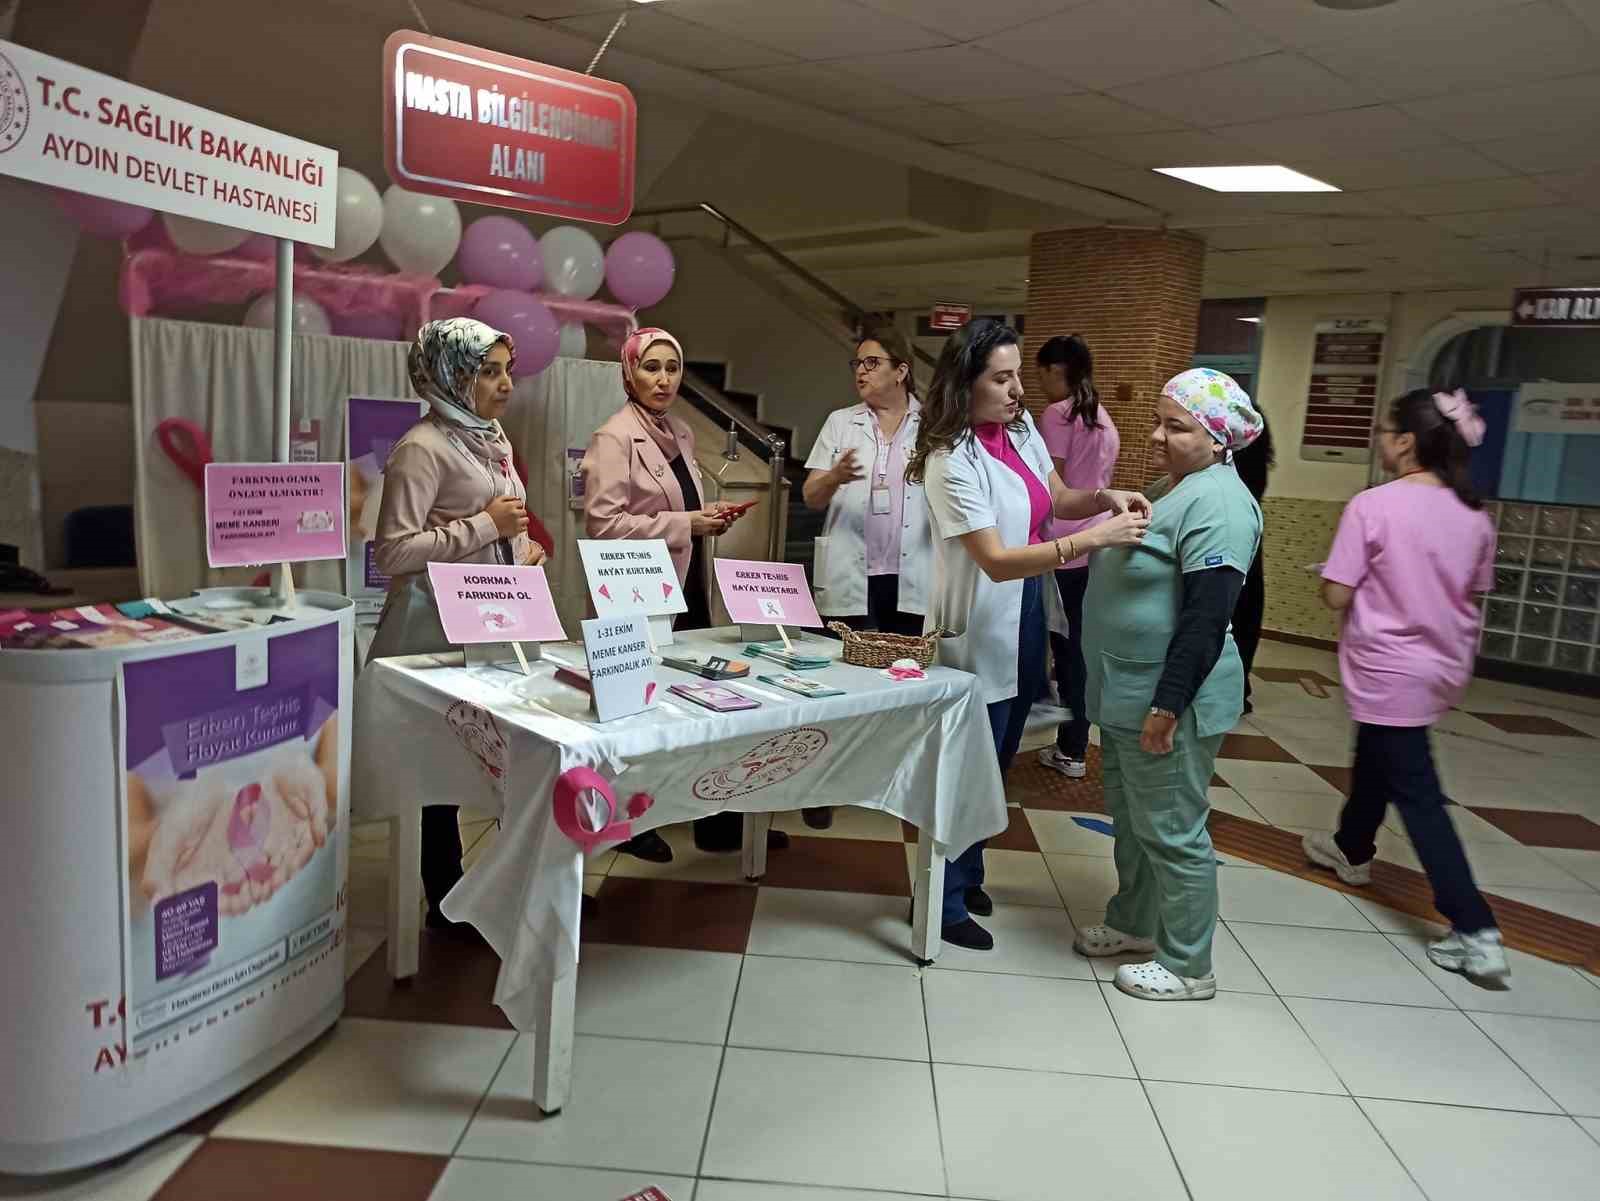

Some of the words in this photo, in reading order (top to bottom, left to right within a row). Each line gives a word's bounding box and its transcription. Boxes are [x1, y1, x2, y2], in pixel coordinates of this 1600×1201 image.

[405, 71, 474, 121] HASTA
[36, 75, 91, 119] T.C.
[97, 97, 194, 150] SAĞLIK
[200, 129, 324, 188] BAKANLIĞI
[489, 143, 546, 185] ALANI
[42, 132, 119, 175] AYDIN
[126, 154, 209, 197] DEVLET
[213, 178, 318, 225] HASTANESİ
[231, 474, 285, 486] FARKINDA
[286, 474, 321, 484] OLMAK
[215, 520, 240, 529] MEME
[599, 551, 626, 561] ERKEN
[597, 567, 625, 577] HAYAT
[625, 565, 664, 576] KURTARIR
[735, 570, 762, 580] ERKEN
[463, 575, 512, 586] KORKMA
[457, 590, 515, 601] FARKINDA
[516, 591, 532, 600] OL
[731, 583, 760, 593] HAYAT
[760, 585, 800, 595] KURTARIR
[597, 626, 613, 639] 1-31
[592, 645, 617, 661] MEME
[618, 640, 646, 656] KANSER
[591, 661, 640, 680] FARKINDALIK
[186, 714, 246, 742] Erken
[249, 695, 301, 726] Teşhis
[186, 734, 242, 763] Hayat
